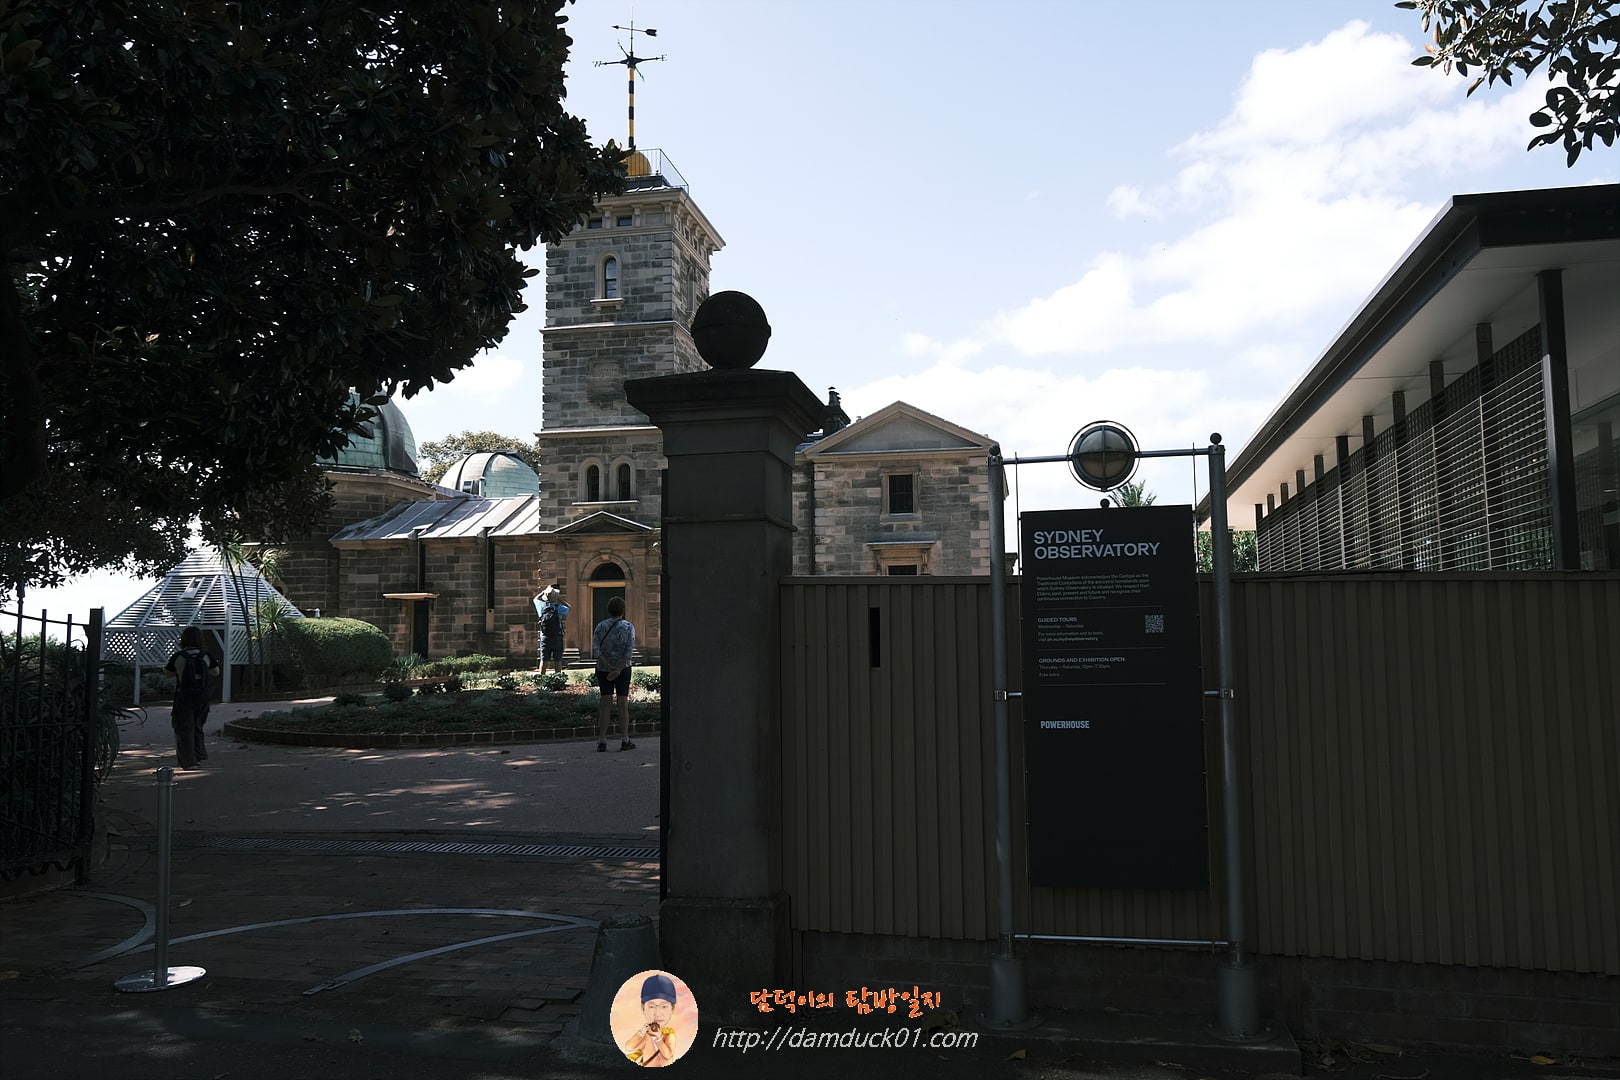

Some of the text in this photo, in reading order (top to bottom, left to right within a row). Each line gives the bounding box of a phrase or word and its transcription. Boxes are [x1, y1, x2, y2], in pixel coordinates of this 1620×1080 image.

[1033, 529, 1104, 545] SYDNEY
[1034, 542, 1160, 560] OBSERVATORY
[1040, 720, 1090, 729] POWERHOUSE
